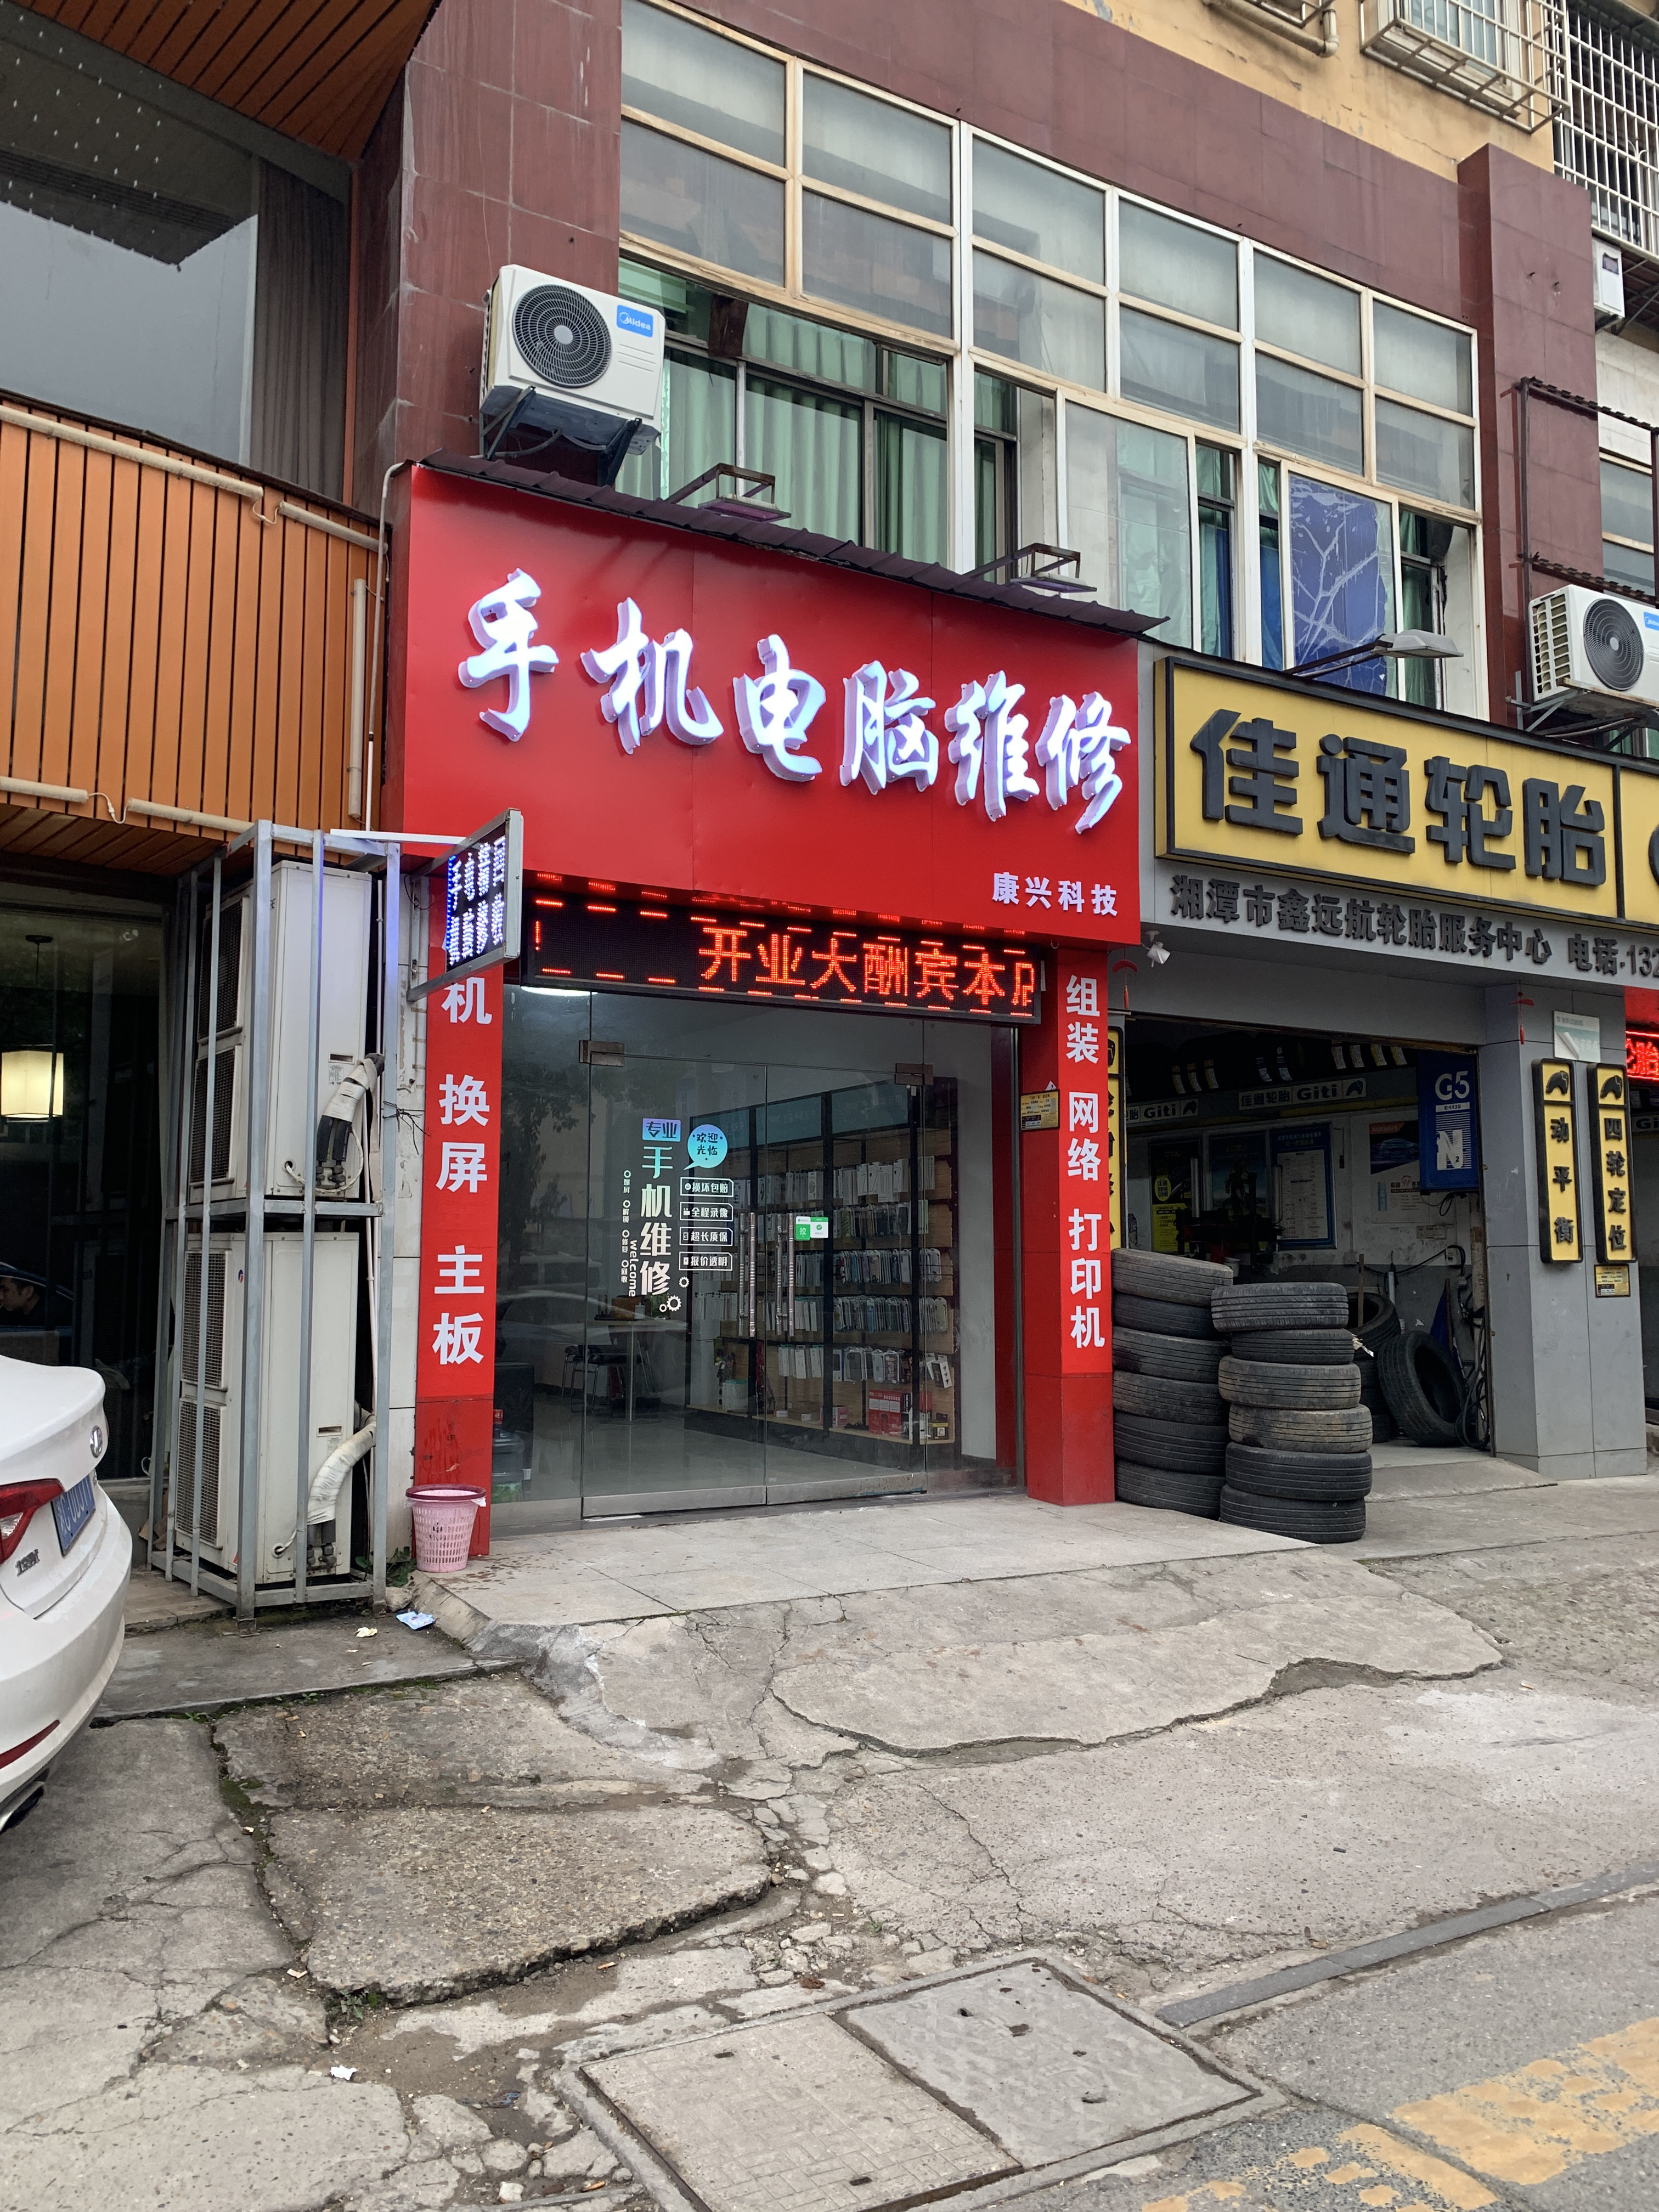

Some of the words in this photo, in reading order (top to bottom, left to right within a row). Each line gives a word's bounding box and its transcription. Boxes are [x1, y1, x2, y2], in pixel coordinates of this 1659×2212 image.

[623, 315, 651, 330] Midea
[456, 567, 1132, 834] 手机电脑维修
[1190, 709, 1606, 886] 佳通轮胎
[991, 871, 1118, 917] 康兴科技
[1170, 874, 1551, 964] 湘潭市鑫远航轮胎服务中心
[1066, 974, 1100, 1064] 组装
[1242, 1088, 1290, 1107] 佳通轮胎
[1296, 1084, 1338, 1101] Giti
[1435, 1070, 1470, 1101] G5
[646, 1121, 678, 1139] 专业
[1143, 1103, 1176, 1119] Giti
[436, 1074, 490, 1193] 换屏
[696, 1132, 718, 1143] 欢迎
[697, 1144, 718, 1155] 光临
[1067, 1091, 1102, 1181] 网络
[691, 1182, 729, 1193] 损坏包赔
[1550, 1117, 1574, 1244] 动平衡
[1604, 1118, 1627, 1251] 四轮定位
[640, 1146, 673, 1296] 手机维修
[691, 1207, 729, 1218] 全程录像
[799, 1227, 806, 1235] 拉
[691, 1231, 728, 1242] 超长质保
[690, 1256, 728, 1267] 报价透明
[1068, 1209, 1105, 1348] 打印机
[433, 1245, 485, 1365] 主板
